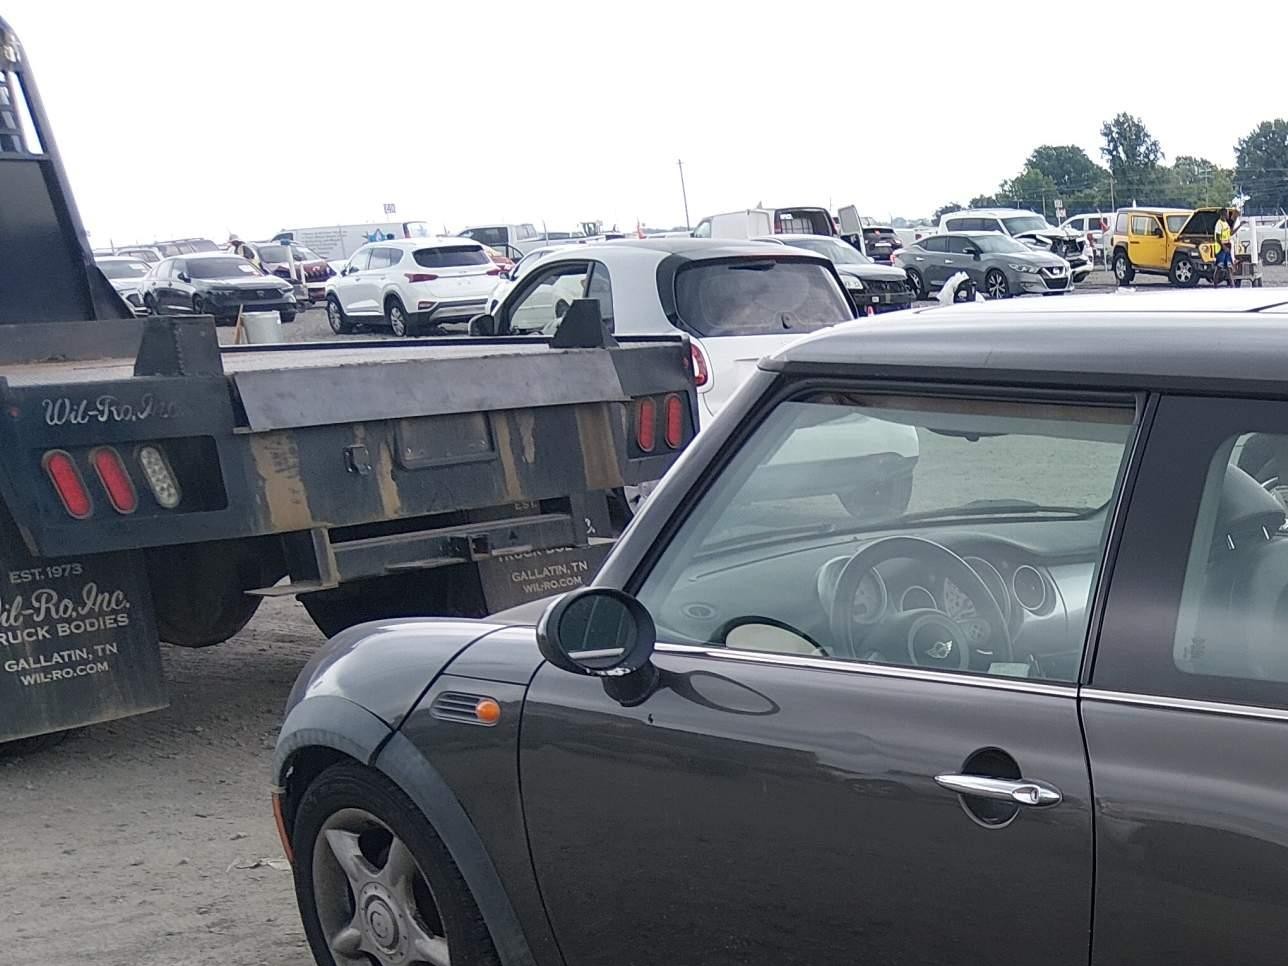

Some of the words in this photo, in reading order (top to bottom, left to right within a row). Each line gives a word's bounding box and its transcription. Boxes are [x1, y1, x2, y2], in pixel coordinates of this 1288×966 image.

[9, 568, 45, 584] EST.
[48, 563, 83, 578] 1973
[511, 563, 571, 582] GALLATIN,
[571, 560, 589, 573] TN
[522, 576, 583, 593] WIL-RO.COM
[57, 613, 129, 637] BODIES
[4, 647, 93, 672] GALLATIN,
[94, 642, 119, 658] TN
[20, 661, 109, 686] WIL-RO.COM
